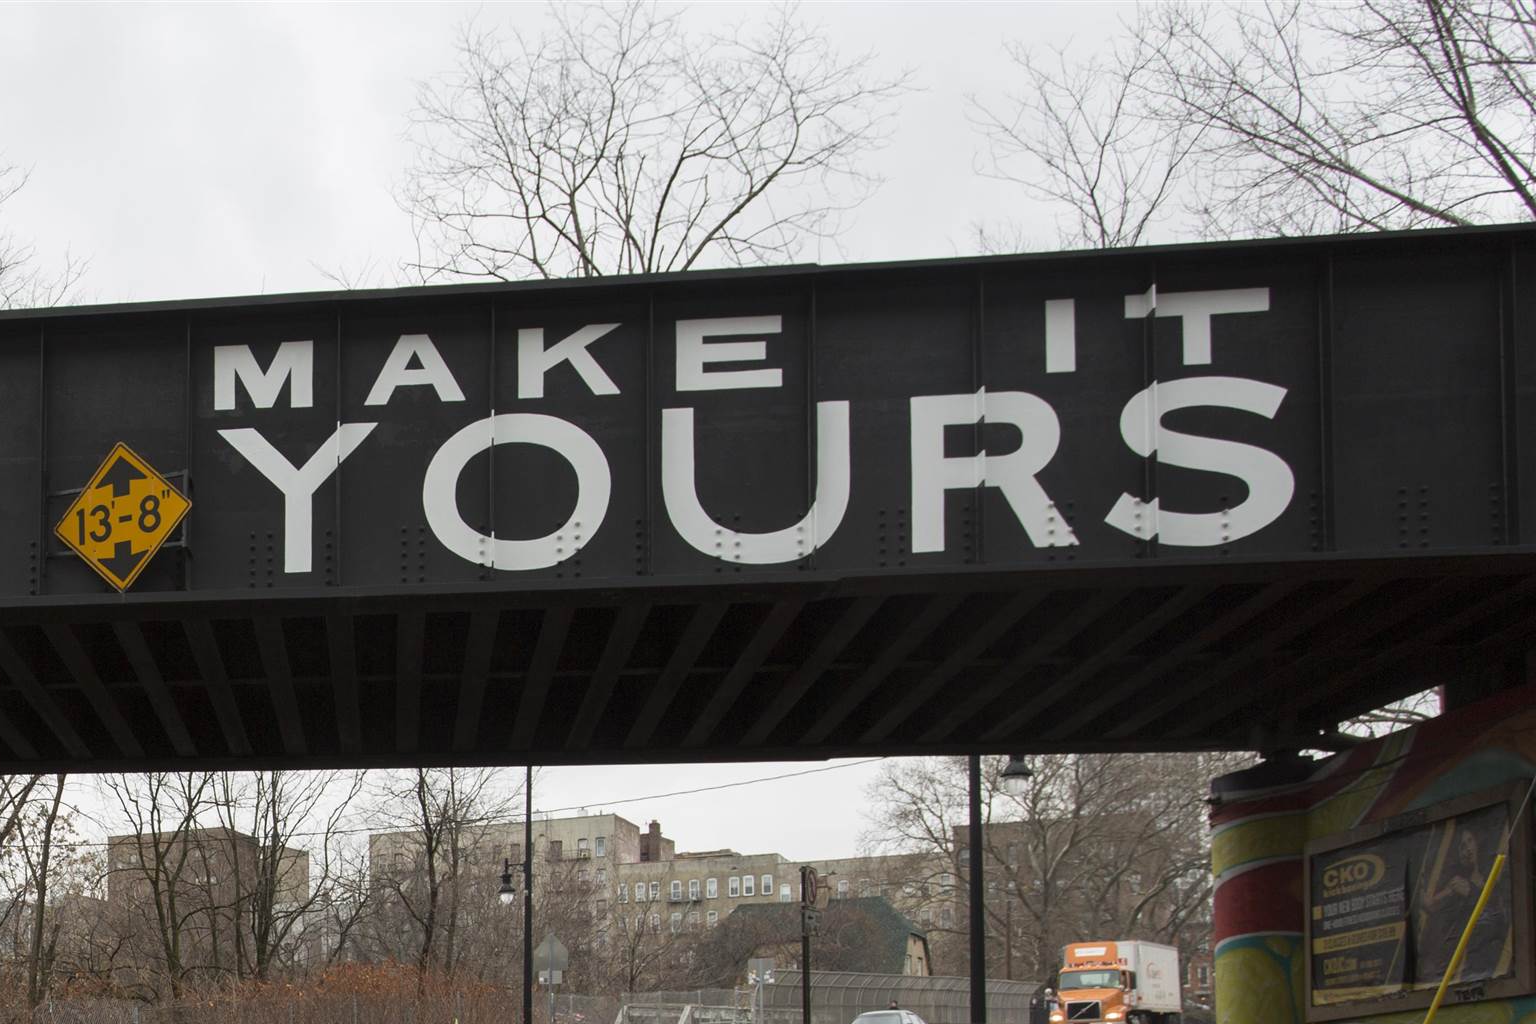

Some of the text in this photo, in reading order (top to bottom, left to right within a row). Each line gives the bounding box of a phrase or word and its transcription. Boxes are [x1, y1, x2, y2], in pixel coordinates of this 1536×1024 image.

[214, 284, 1270, 411] MAKE IT
[217, 376, 1295, 573] YOURS
[1323, 861, 1369, 888] CKO
